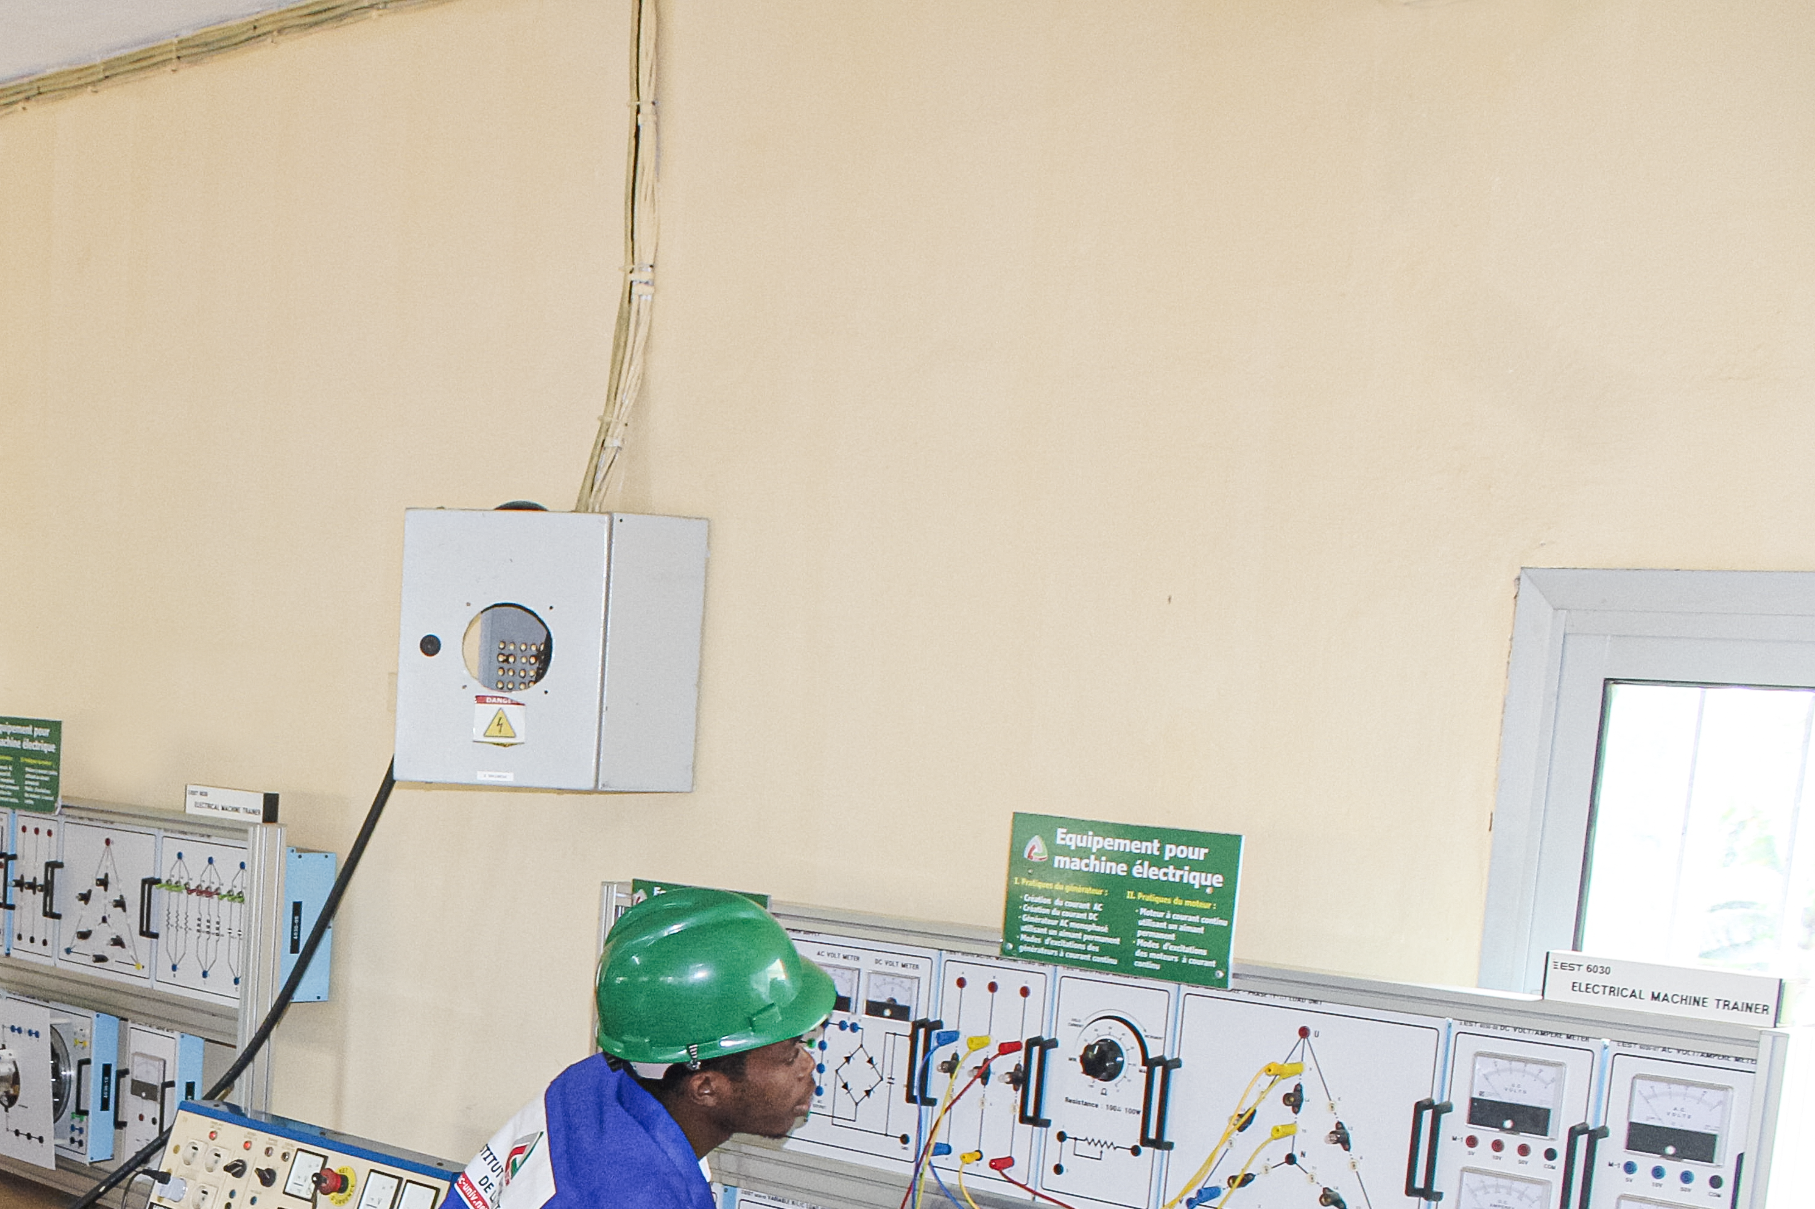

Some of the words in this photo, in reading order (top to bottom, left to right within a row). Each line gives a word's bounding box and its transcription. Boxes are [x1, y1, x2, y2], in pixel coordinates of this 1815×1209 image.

[1056, 827, 1161, 856] Equipement
[1164, 842, 1209, 861] pour
[1053, 854, 1128, 876] machine
[1132, 859, 1224, 888] électrique
[1021, 878, 1054, 890] Pratiques
[1054, 882, 1064, 890] du
[1065, 884, 1104, 896] générateur
[1024, 894, 1052, 904] Création
[1054, 898, 1064, 906] du
[1064, 901, 1090, 910] courant
[1093, 903, 1104, 912] AC
[1138, 892, 1172, 904] Pratiques
[1172, 896, 1183, 906] du
[1184, 900, 1212, 909] moteur
[1022, 914, 1059, 926] Générateur
[1059, 919, 1069, 928] AC
[1023, 904, 1051, 915] Création
[1051, 908, 1061, 916] du
[1061, 911, 1087, 920] courant
[1088, 912, 1099, 921] DC
[1139, 907, 1165, 918] Moteur
[1166, 910, 1171, 919] à
[1172, 913, 1200, 923] courant
[1200, 917, 1229, 927] continu
[1138, 918, 1167, 929] utilisant
[1020, 924, 1048, 934] utilisant
[1083, 934, 1121, 945] permanent
[1020, 934, 1042, 944] Modes
[1044, 937, 1086, 951] d'excitations
[1086, 943, 1100, 952] des
[1136, 930, 1176, 941] permanent
[1019, 945, 1058, 956] générateurs
[1059, 949, 1064, 957] à
[1065, 952, 1091, 961] courant
[1092, 955, 1118, 965] continu
[1136, 938, 1160, 949] Modes
[1162, 942, 1208, 956] d'excitations
[901, 962, 920, 970] METER
[1134, 960, 1161, 970] continu
[1135, 948, 1148, 958] des
[1148, 952, 1179, 962] moteurs
[1182, 955, 1187, 964] à
[1188, 958, 1217, 968] courant
[1586, 963, 1612, 976] 6030
[1571, 981, 1646, 1001] ELECTRICAL
[1650, 991, 1709, 1008] MACHINE
[1714, 998, 1770, 1016] TRAINER
[1512, 1026, 1564, 1039] VOLT/AMPERE
[1566, 1031, 1590, 1042] METER
[1661, 1046, 1672, 1054] AC
[1676, 1048, 1732, 1062] VOLT/AMPERE
[1064, 1096, 1099, 1109] Resistance
[1124, 1107, 1141, 1116] 100W
[478, 1176, 495, 1194] DE
